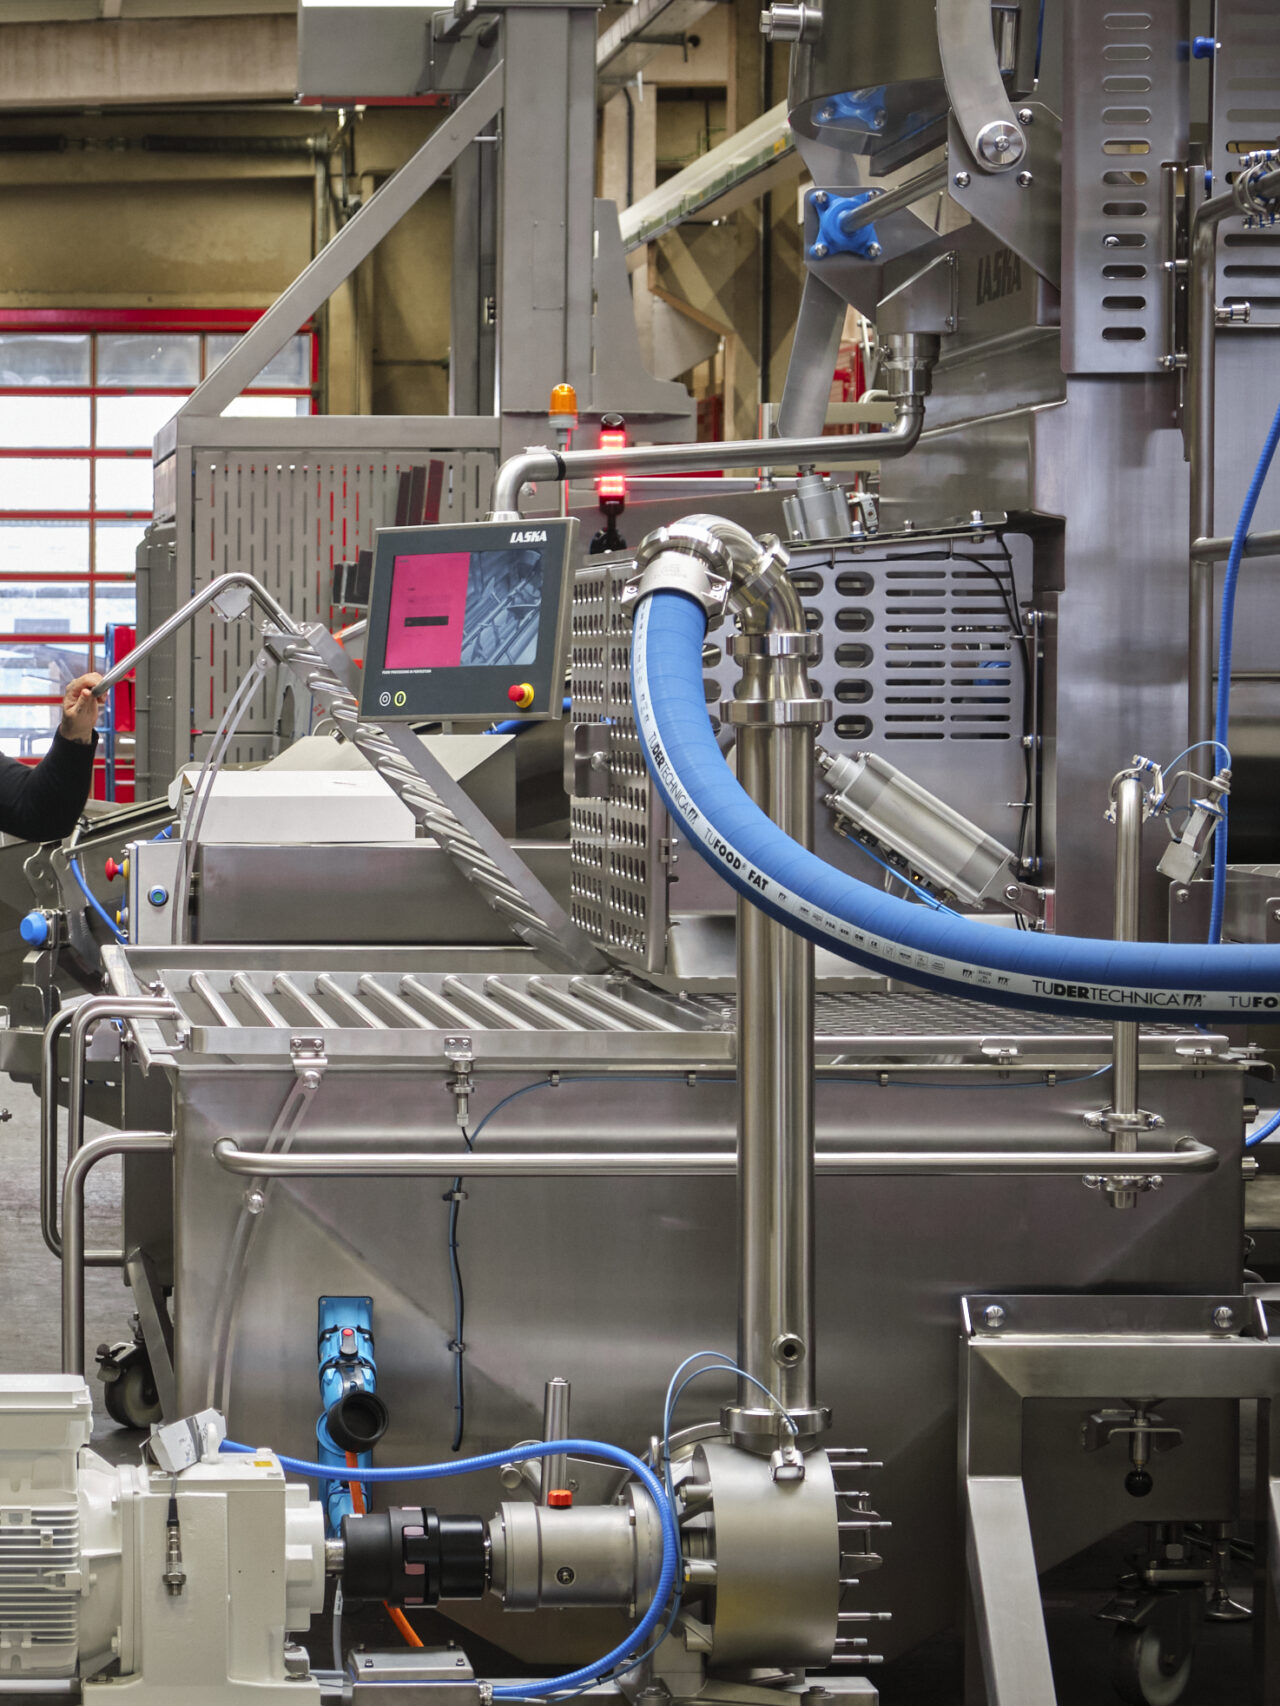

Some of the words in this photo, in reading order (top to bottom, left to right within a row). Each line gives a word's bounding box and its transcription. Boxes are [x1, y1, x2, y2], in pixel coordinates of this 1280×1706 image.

[976, 248, 1021, 306] LASKA
[510, 530, 547, 543] LASKA
[648, 731, 689, 815] TUDERTECHNICA
[748, 870, 769, 890] FAT
[1032, 979, 1180, 1006] TUDERTECHNICA
